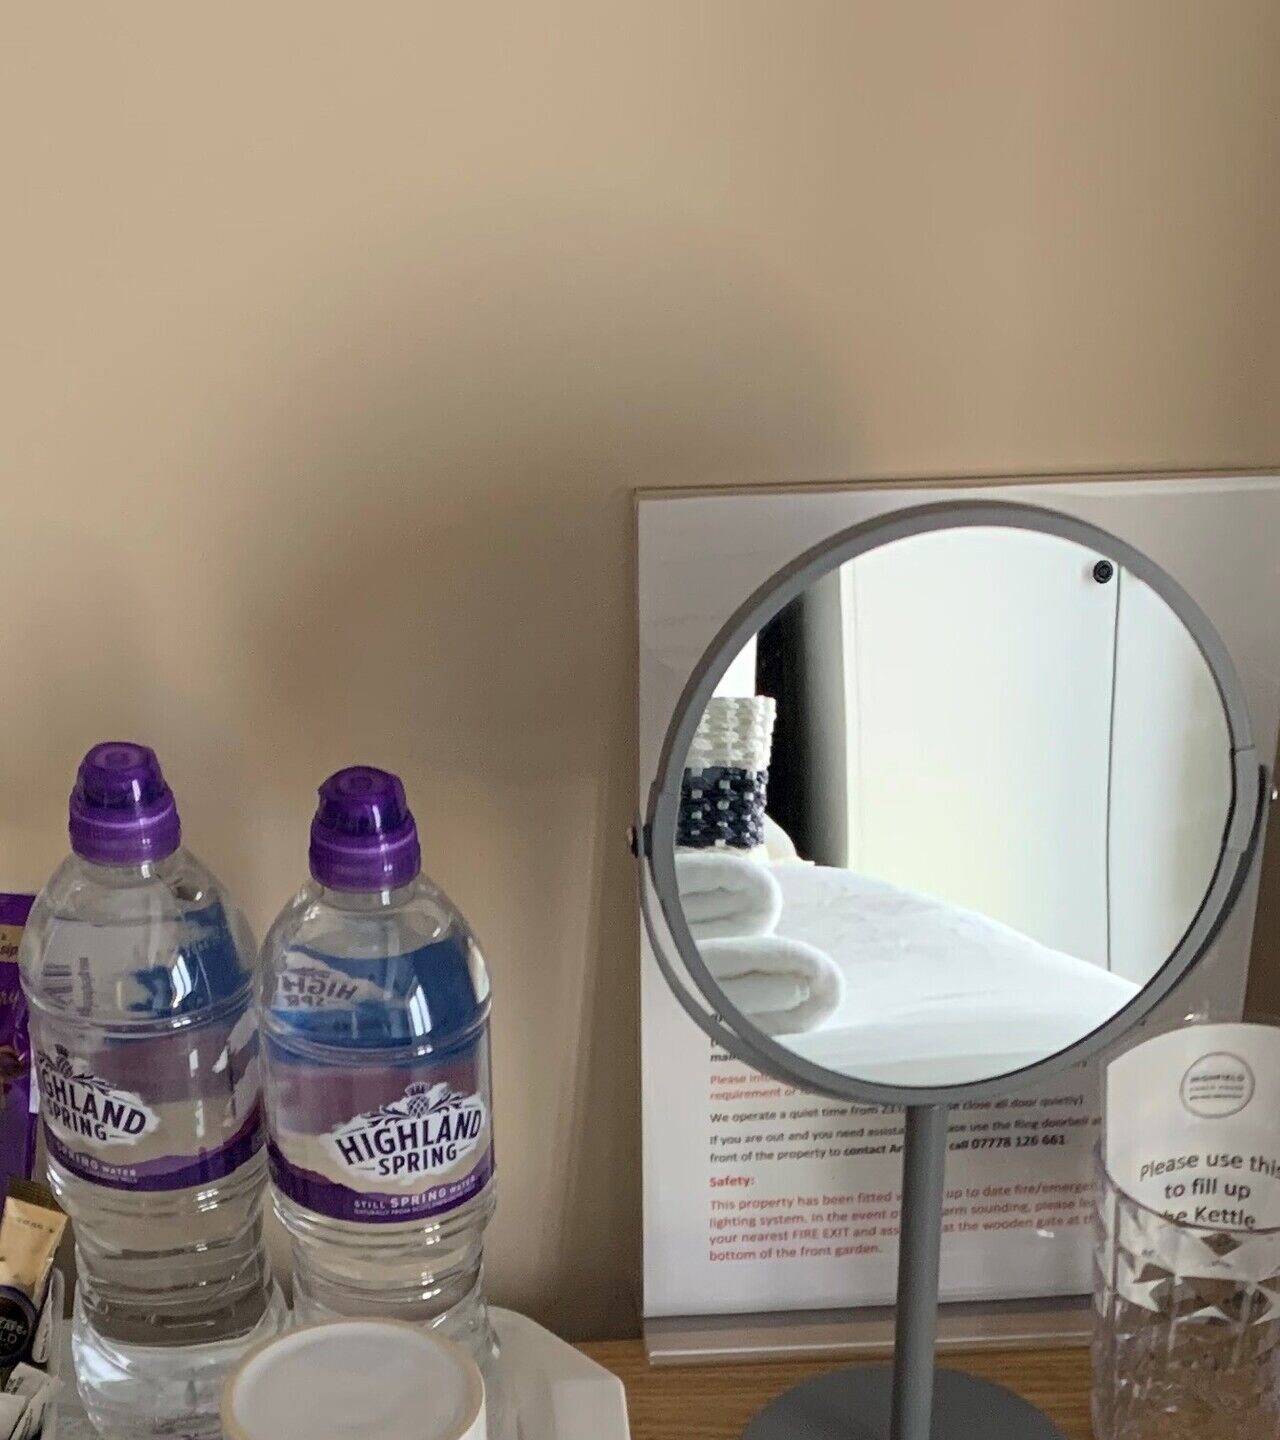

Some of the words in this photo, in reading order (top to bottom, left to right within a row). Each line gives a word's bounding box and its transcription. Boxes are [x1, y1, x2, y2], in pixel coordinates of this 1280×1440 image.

[0, 945, 20, 959] sip
[709, 1074, 747, 1086] Please
[709, 1087, 781, 1102] requirement
[710, 1113, 728, 1123] We
[732, 1112, 776, 1124] operate
[789, 1108, 819, 1120] quiet
[821, 1106, 848, 1117] time
[850, 1105, 878, 1116] from
[335, 1108, 483, 1166] HIGHLAND
[721, 1136, 742, 1147] you
[745, 1135, 763, 1144] are
[765, 1132, 785, 1143] out
[789, 1131, 810, 1142] and
[812, 1131, 834, 1142] you
[836, 1128, 865, 1139] need
[867, 1126, 906, 1138] assista
[992, 1121, 1011, 1131] the
[378, 1142, 458, 1176] SPRING
[710, 1153, 738, 1164] front
[741, 1151, 752, 1163] of
[755, 1150, 775, 1161] the
[777, 1149, 826, 1162] property
[829, 1147, 841, 1158] to
[843, 1145, 887, 1157] contact
[949, 1140, 969, 1151] call
[971, 1136, 1012, 1150] 07778
[1015, 1135, 1039, 1147] 126
[1042, 1134, 1066, 1146] 661
[1139, 1152, 1201, 1182] Please
[1206, 1152, 1244, 1171] use
[709, 1176, 756, 1188] Safety:
[1164, 1181, 1187, 1200] to
[1191, 1177, 1218, 1196] fill
[1223, 1181, 1252, 1202] up
[353, 1199, 387, 1210] STILL
[389, 1187, 447, 1209] SPRING
[710, 1200, 736, 1211] This
[739, 1199, 794, 1212] property
[798, 1196, 819, 1207] has
[822, 1194, 854, 1206] been
[858, 1192, 892, 1203] fitted
[946, 1189, 963, 1201] up
[966, 1187, 980, 1199] to
[983, 1185, 1012, 1197] date
[709, 1217, 757, 1231] lighting
[811, 1213, 824, 1223] In
[827, 1211, 849, 1222] the
[852, 1210, 888, 1221] event
[1035, 1199, 1075, 1213] please
[1194, 1205, 1257, 1229] Kettle
[709, 1234, 738, 1246] your
[741, 1231, 789, 1244] nearest
[792, 1229, 819, 1240] FIRE
[822, 1228, 849, 1239] EXIT
[852, 1226, 877, 1238] and
[958, 1221, 980, 1232] the
[982, 1218, 1034, 1232] wooden
[1036, 1217, 1064, 1229] gate
[709, 1250, 757, 1262] bottom
[760, 1248, 773, 1260] of
[776, 1247, 797, 1259] the
[800, 1245, 832, 1258] front
[834, 1244, 881, 1258] garden.
